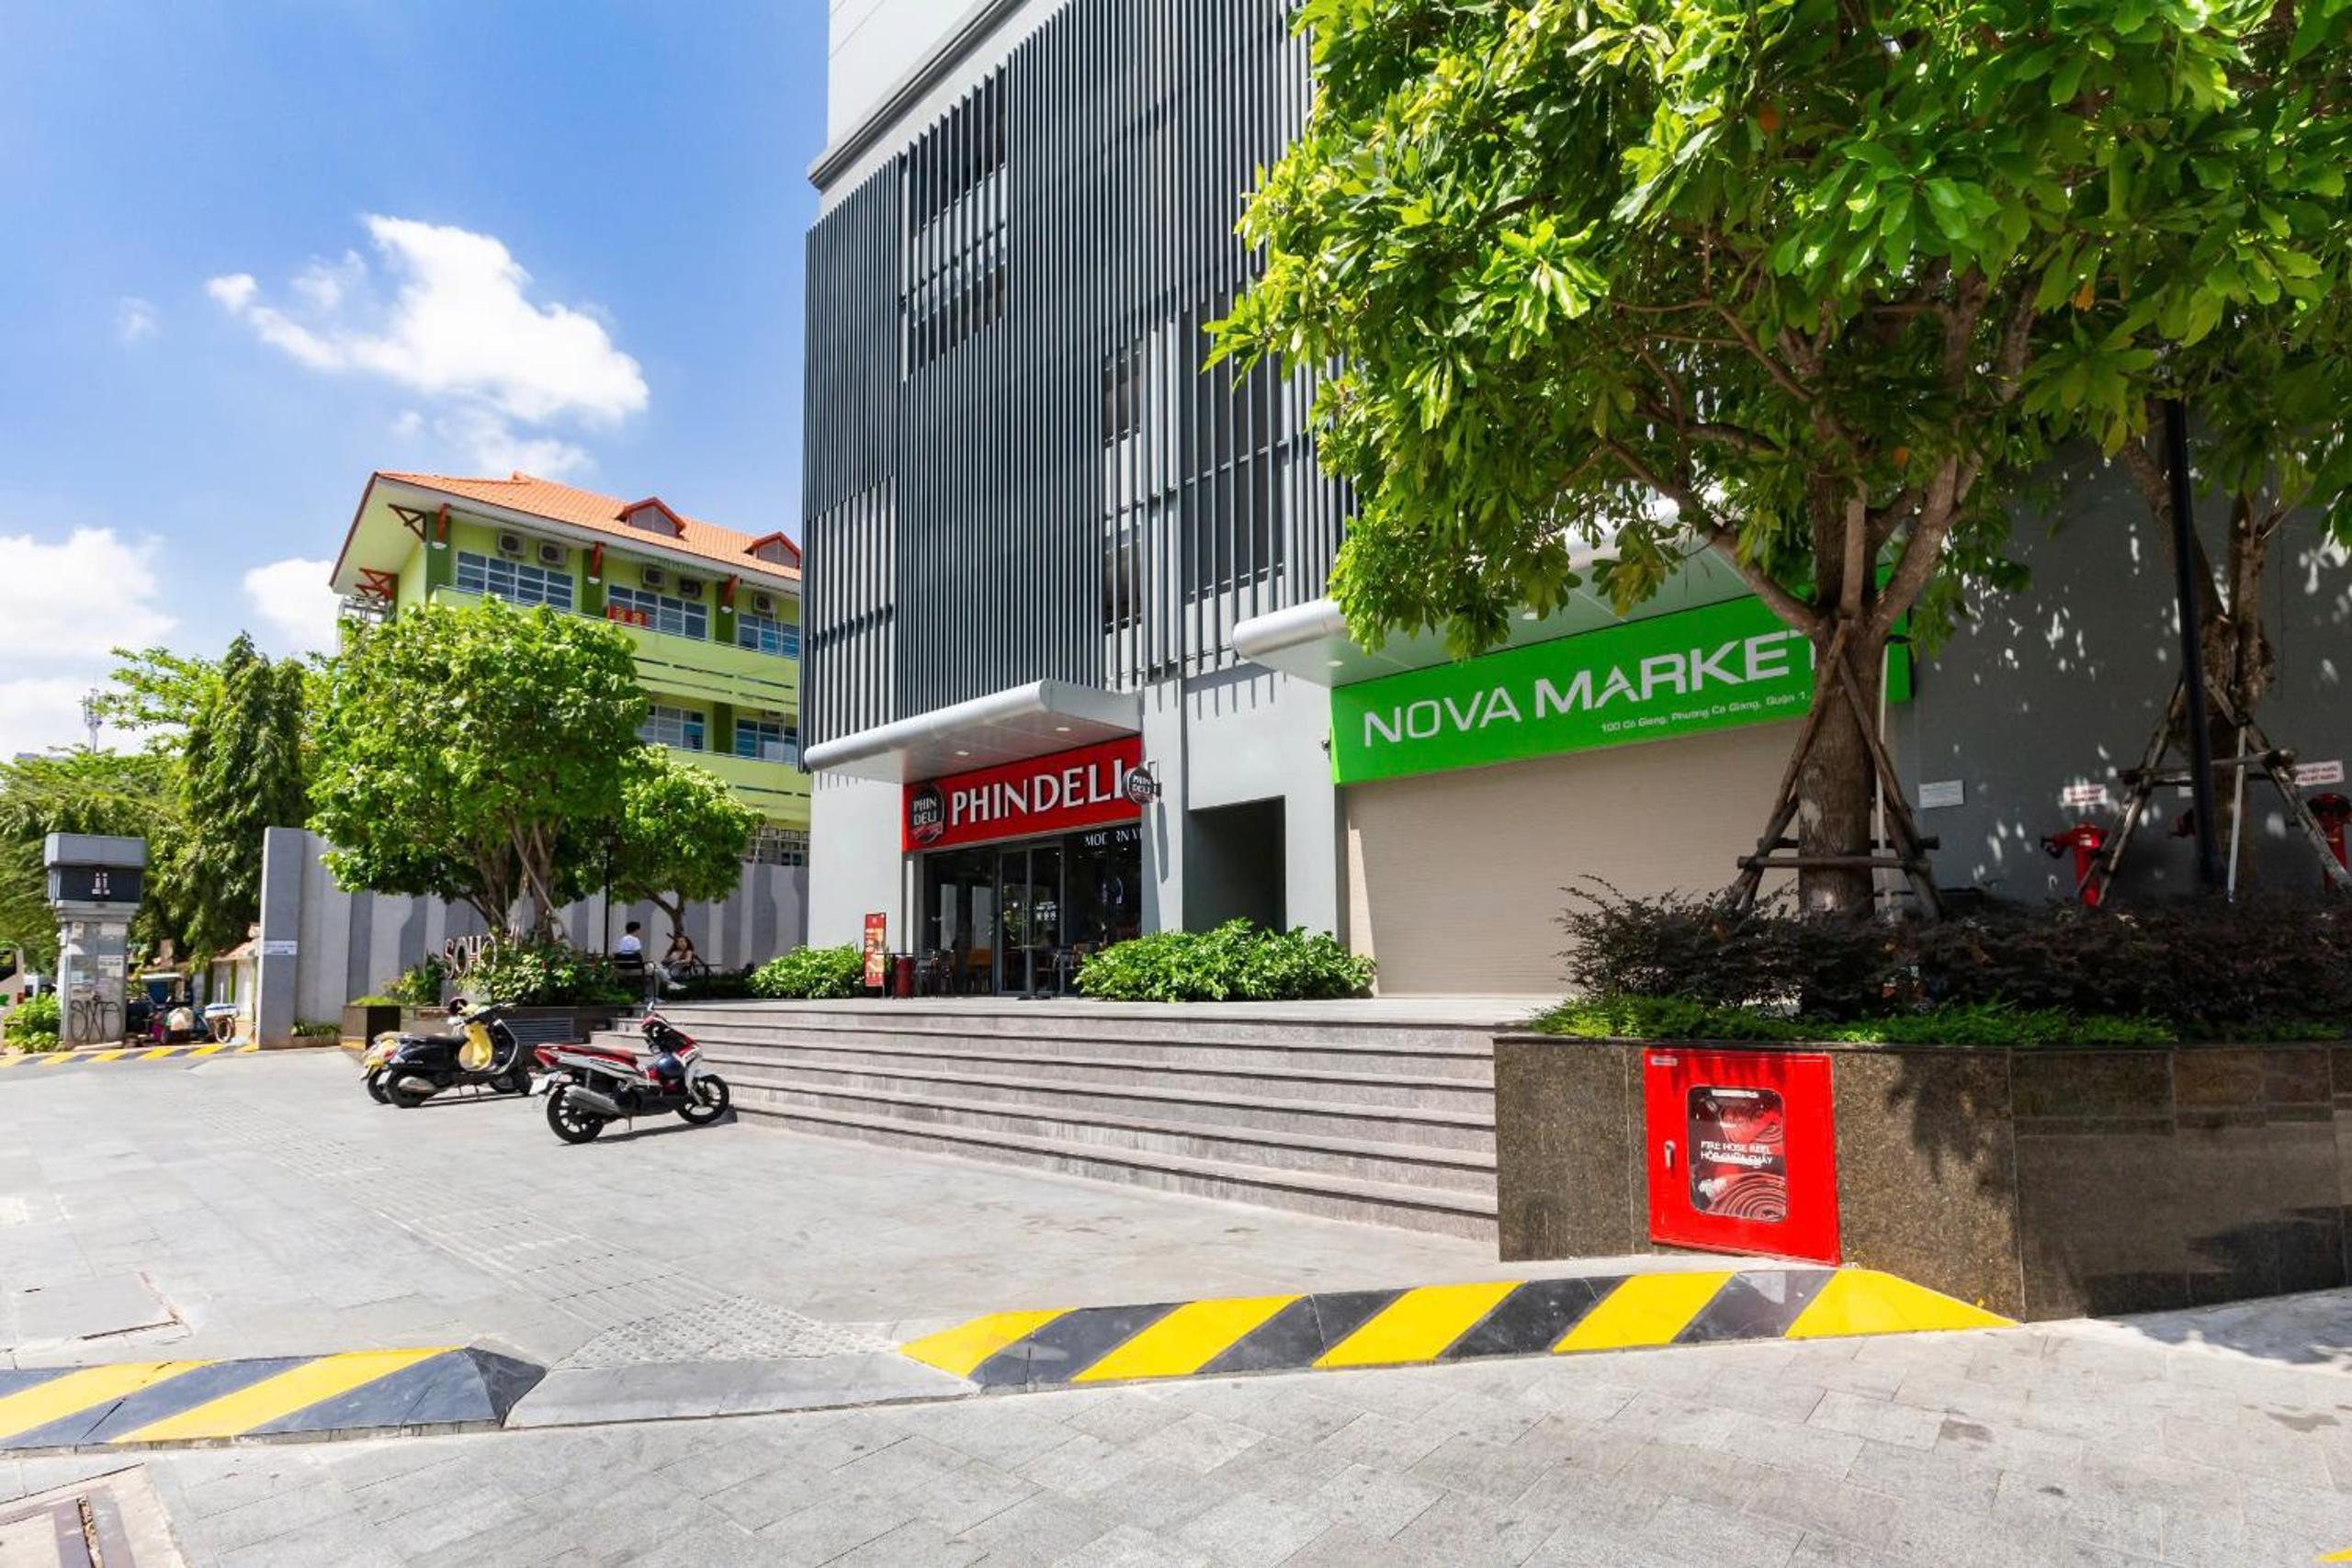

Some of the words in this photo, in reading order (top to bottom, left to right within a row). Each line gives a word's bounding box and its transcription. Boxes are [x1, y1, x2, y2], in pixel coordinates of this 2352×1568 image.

[1363, 685, 1522, 748] NOVA
[1601, 721, 1621, 733] 100
[951, 758, 1124, 826] PHINDELI
[913, 796, 937, 812] PHIN
[913, 809, 937, 826] DELI
[444, 932, 498, 979] SOHO
[1701, 1140, 1722, 1150] FIRE
